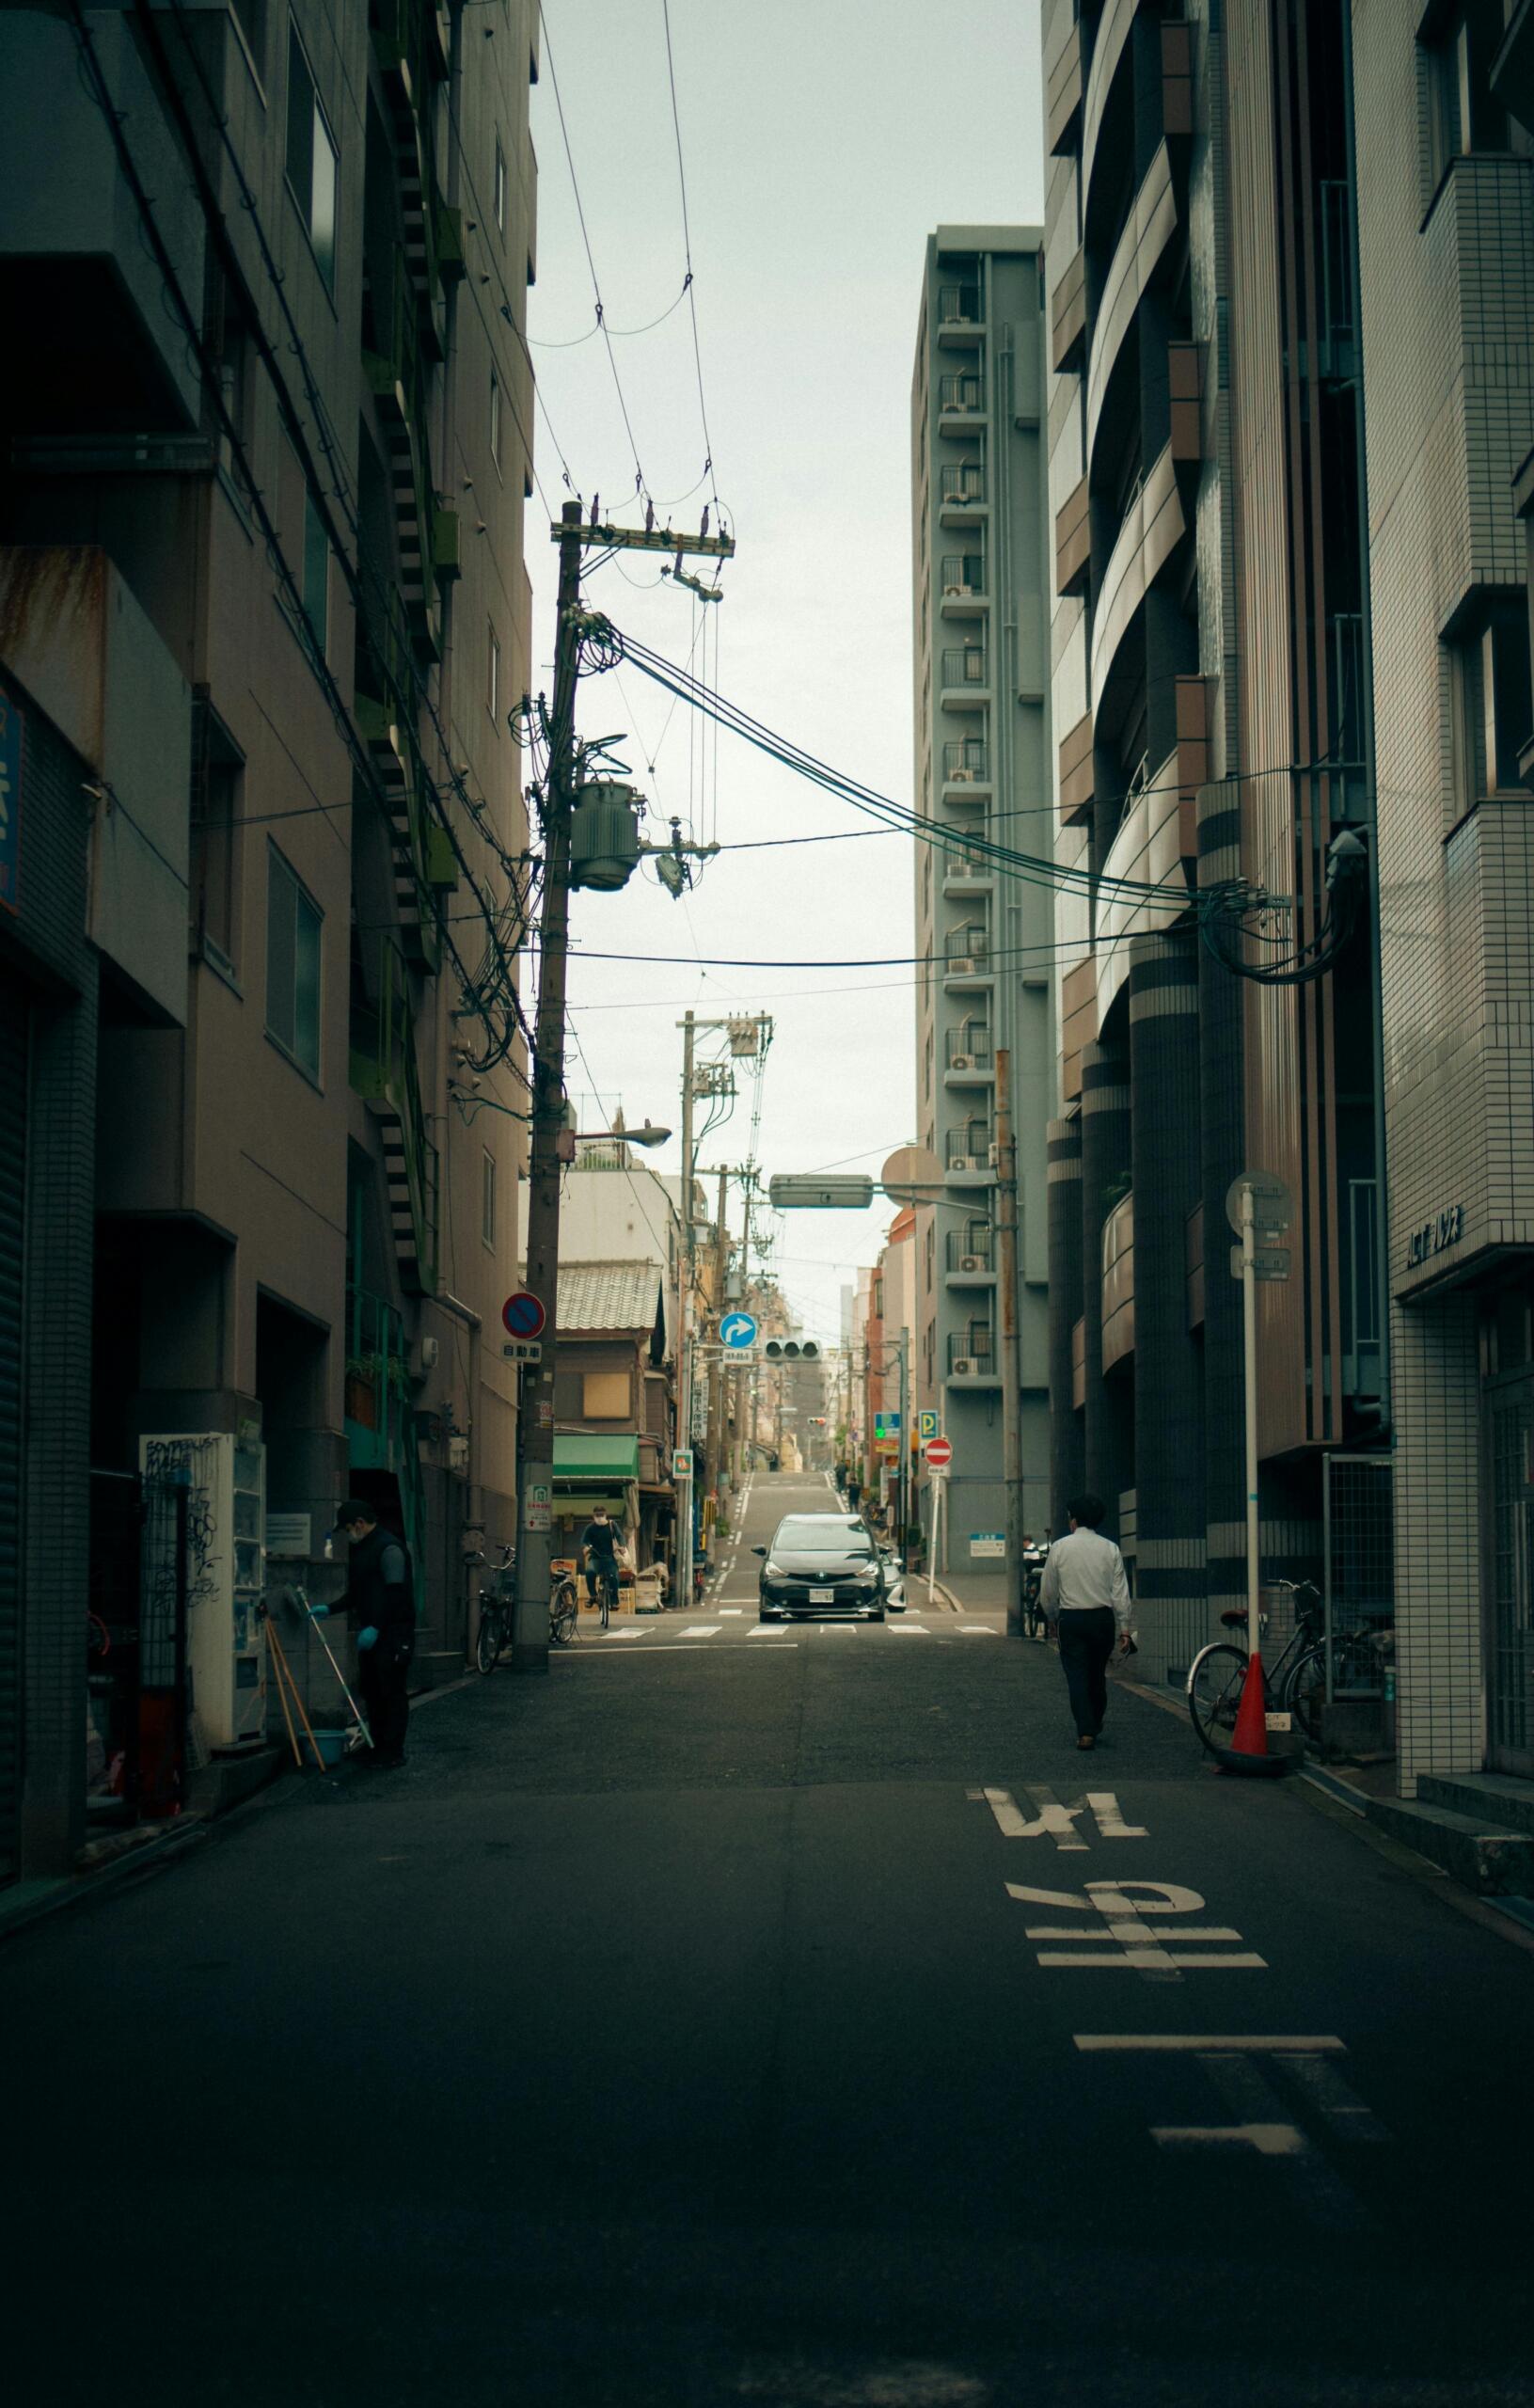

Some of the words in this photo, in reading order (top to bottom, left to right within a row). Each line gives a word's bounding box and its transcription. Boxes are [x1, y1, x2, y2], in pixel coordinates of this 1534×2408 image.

[503, 1345, 540, 1358] 自動車
[924, 1415, 935, 1435] P
